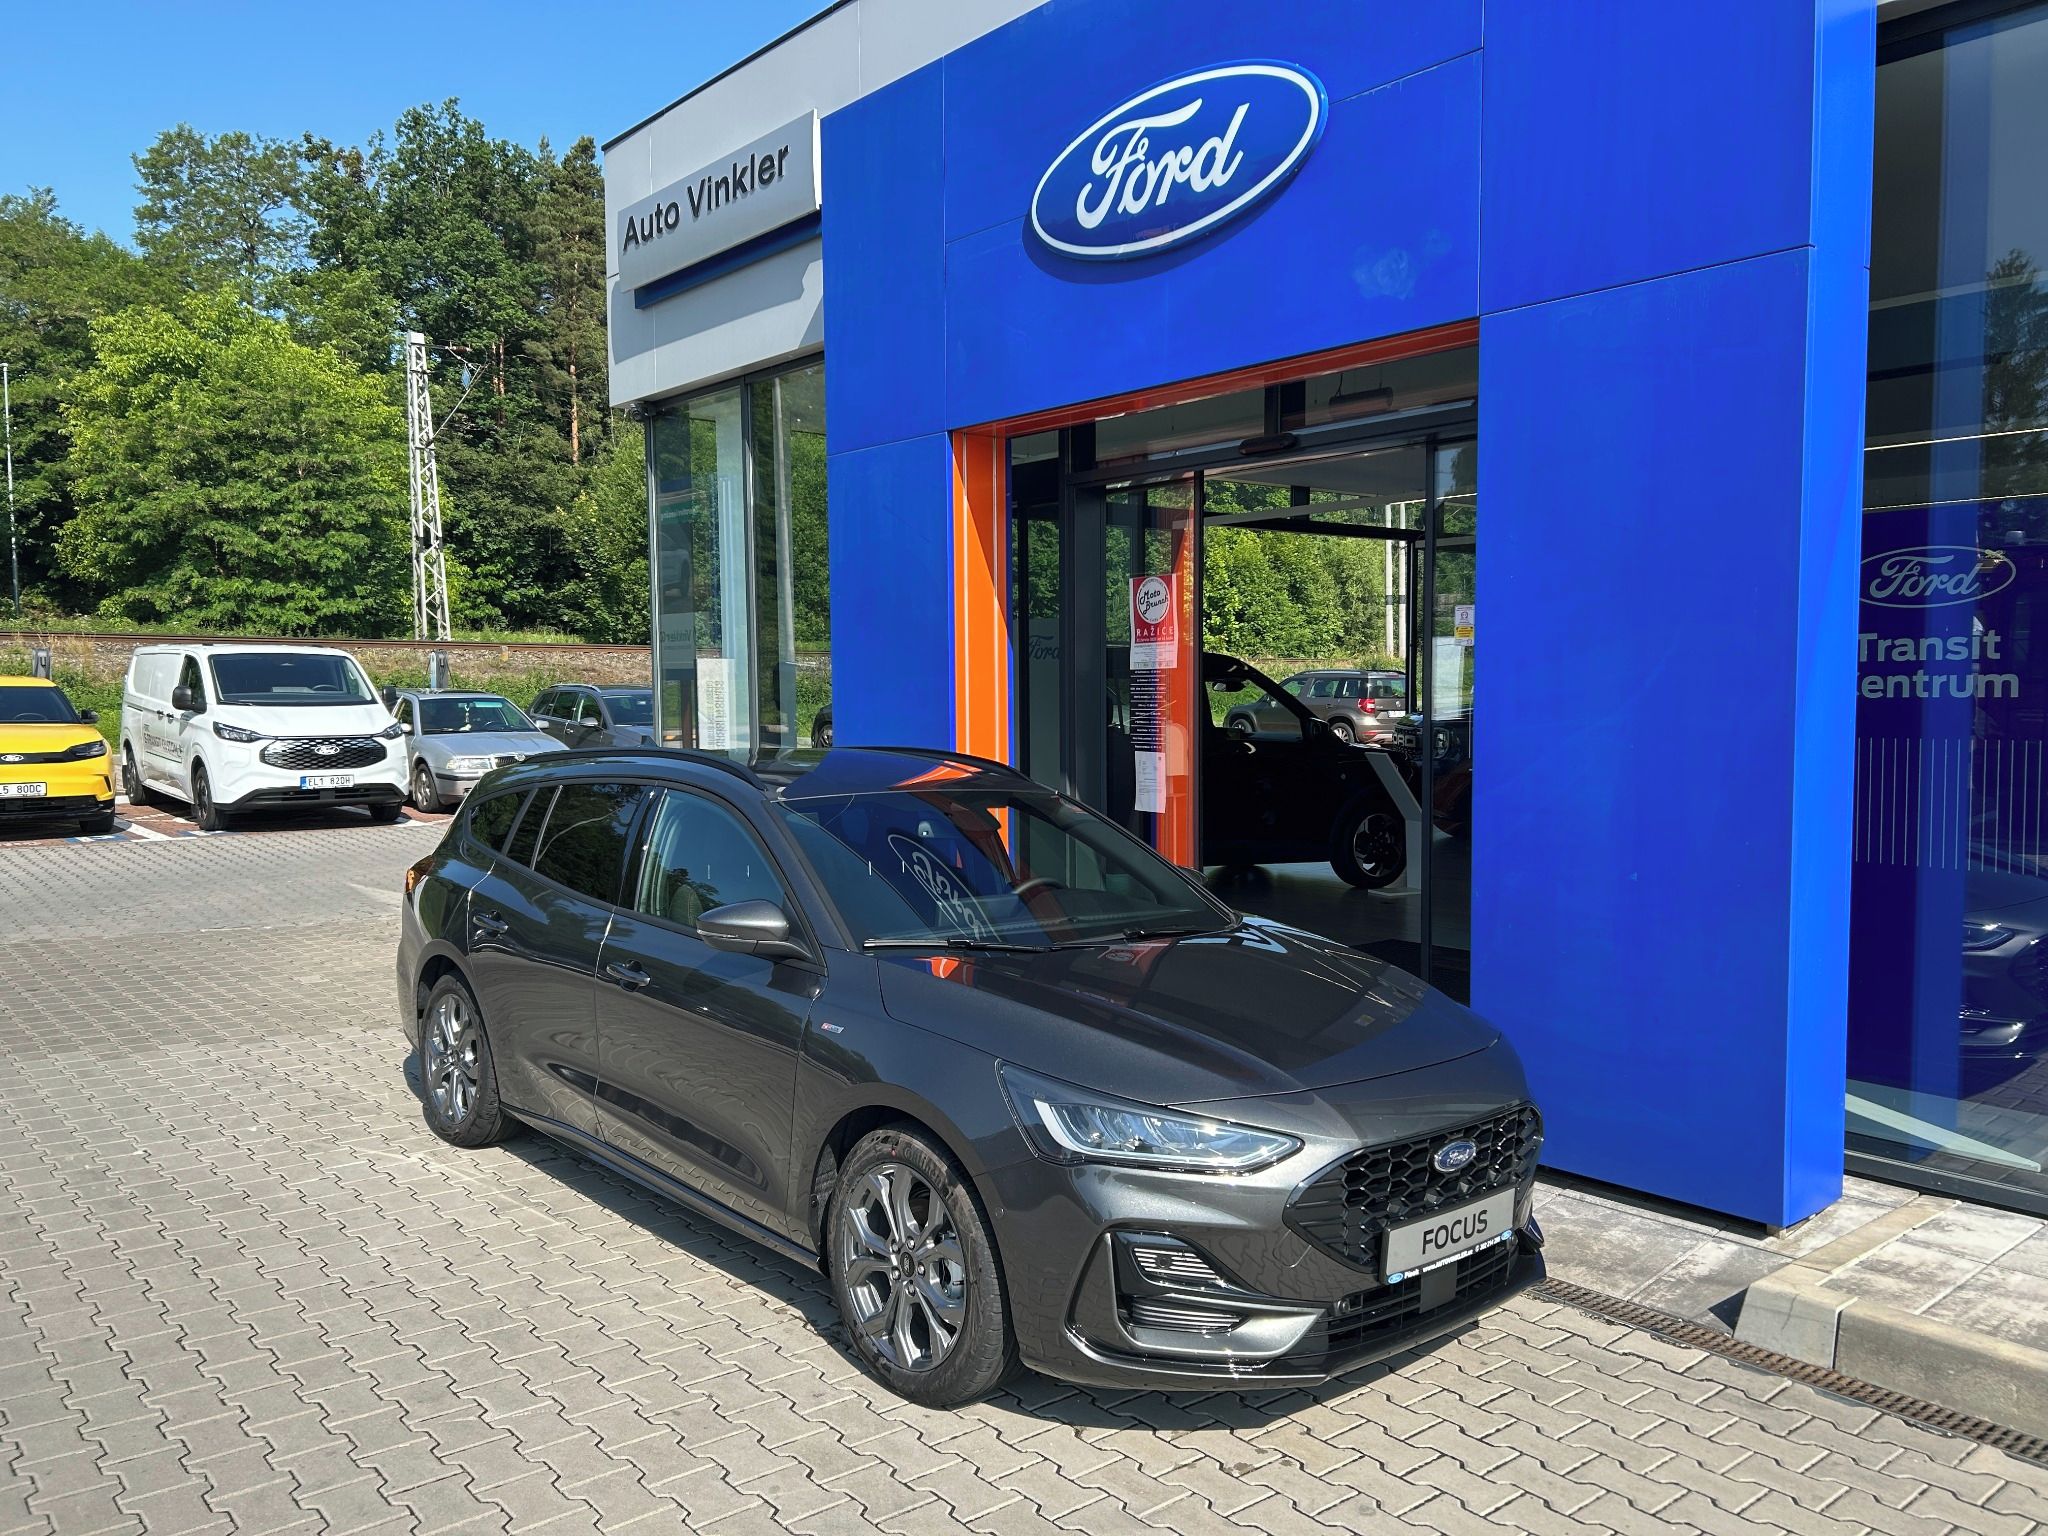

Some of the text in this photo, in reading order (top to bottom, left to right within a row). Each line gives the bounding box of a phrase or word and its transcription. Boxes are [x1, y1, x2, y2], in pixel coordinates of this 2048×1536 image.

[1076, 98, 1250, 229] Ford
[623, 144, 789, 251] Auto Vinkler
[1869, 554, 1983, 598] Ford
[1140, 590, 1160, 605] Moto
[1143, 595, 1169, 615] Brunch
[1136, 625, 1174, 637] RAŽICE
[1857, 629, 2001, 662] Transit
[1857, 669, 2019, 699] entrum
[1422, 1209, 1488, 1255] FOCUS
